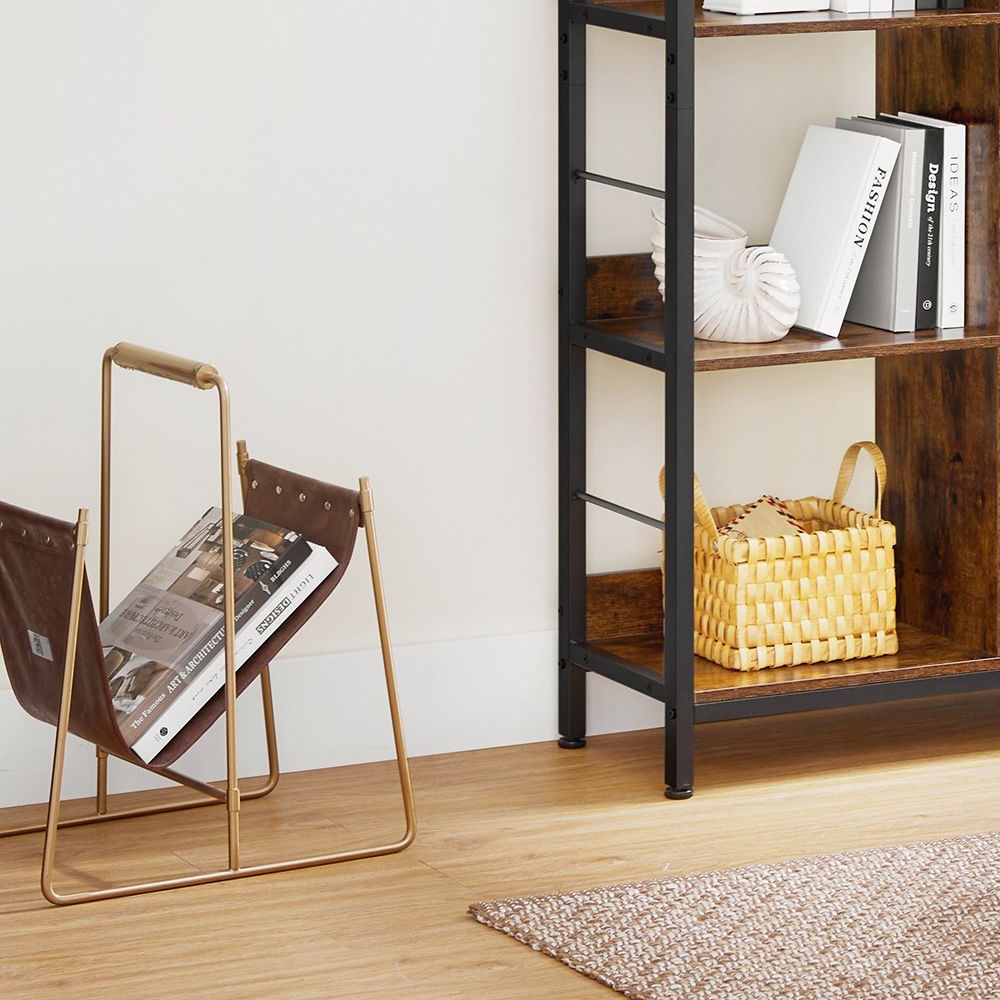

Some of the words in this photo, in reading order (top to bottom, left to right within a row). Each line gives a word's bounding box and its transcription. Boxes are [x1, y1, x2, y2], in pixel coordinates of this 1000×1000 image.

[853, 166, 887, 248] FASHION
[925, 162, 939, 213] Design
[950, 156, 959, 213] IDEAS
[291, 573, 314, 599] LIGHT
[256, 597, 291, 634] DESIGNS
[130, 716, 144, 730] The
[143, 693, 166, 718] Famous
[166, 675, 183, 694] ART
[185, 625, 226, 674] ARCHITECTU
[233, 599, 255, 622] Designer
